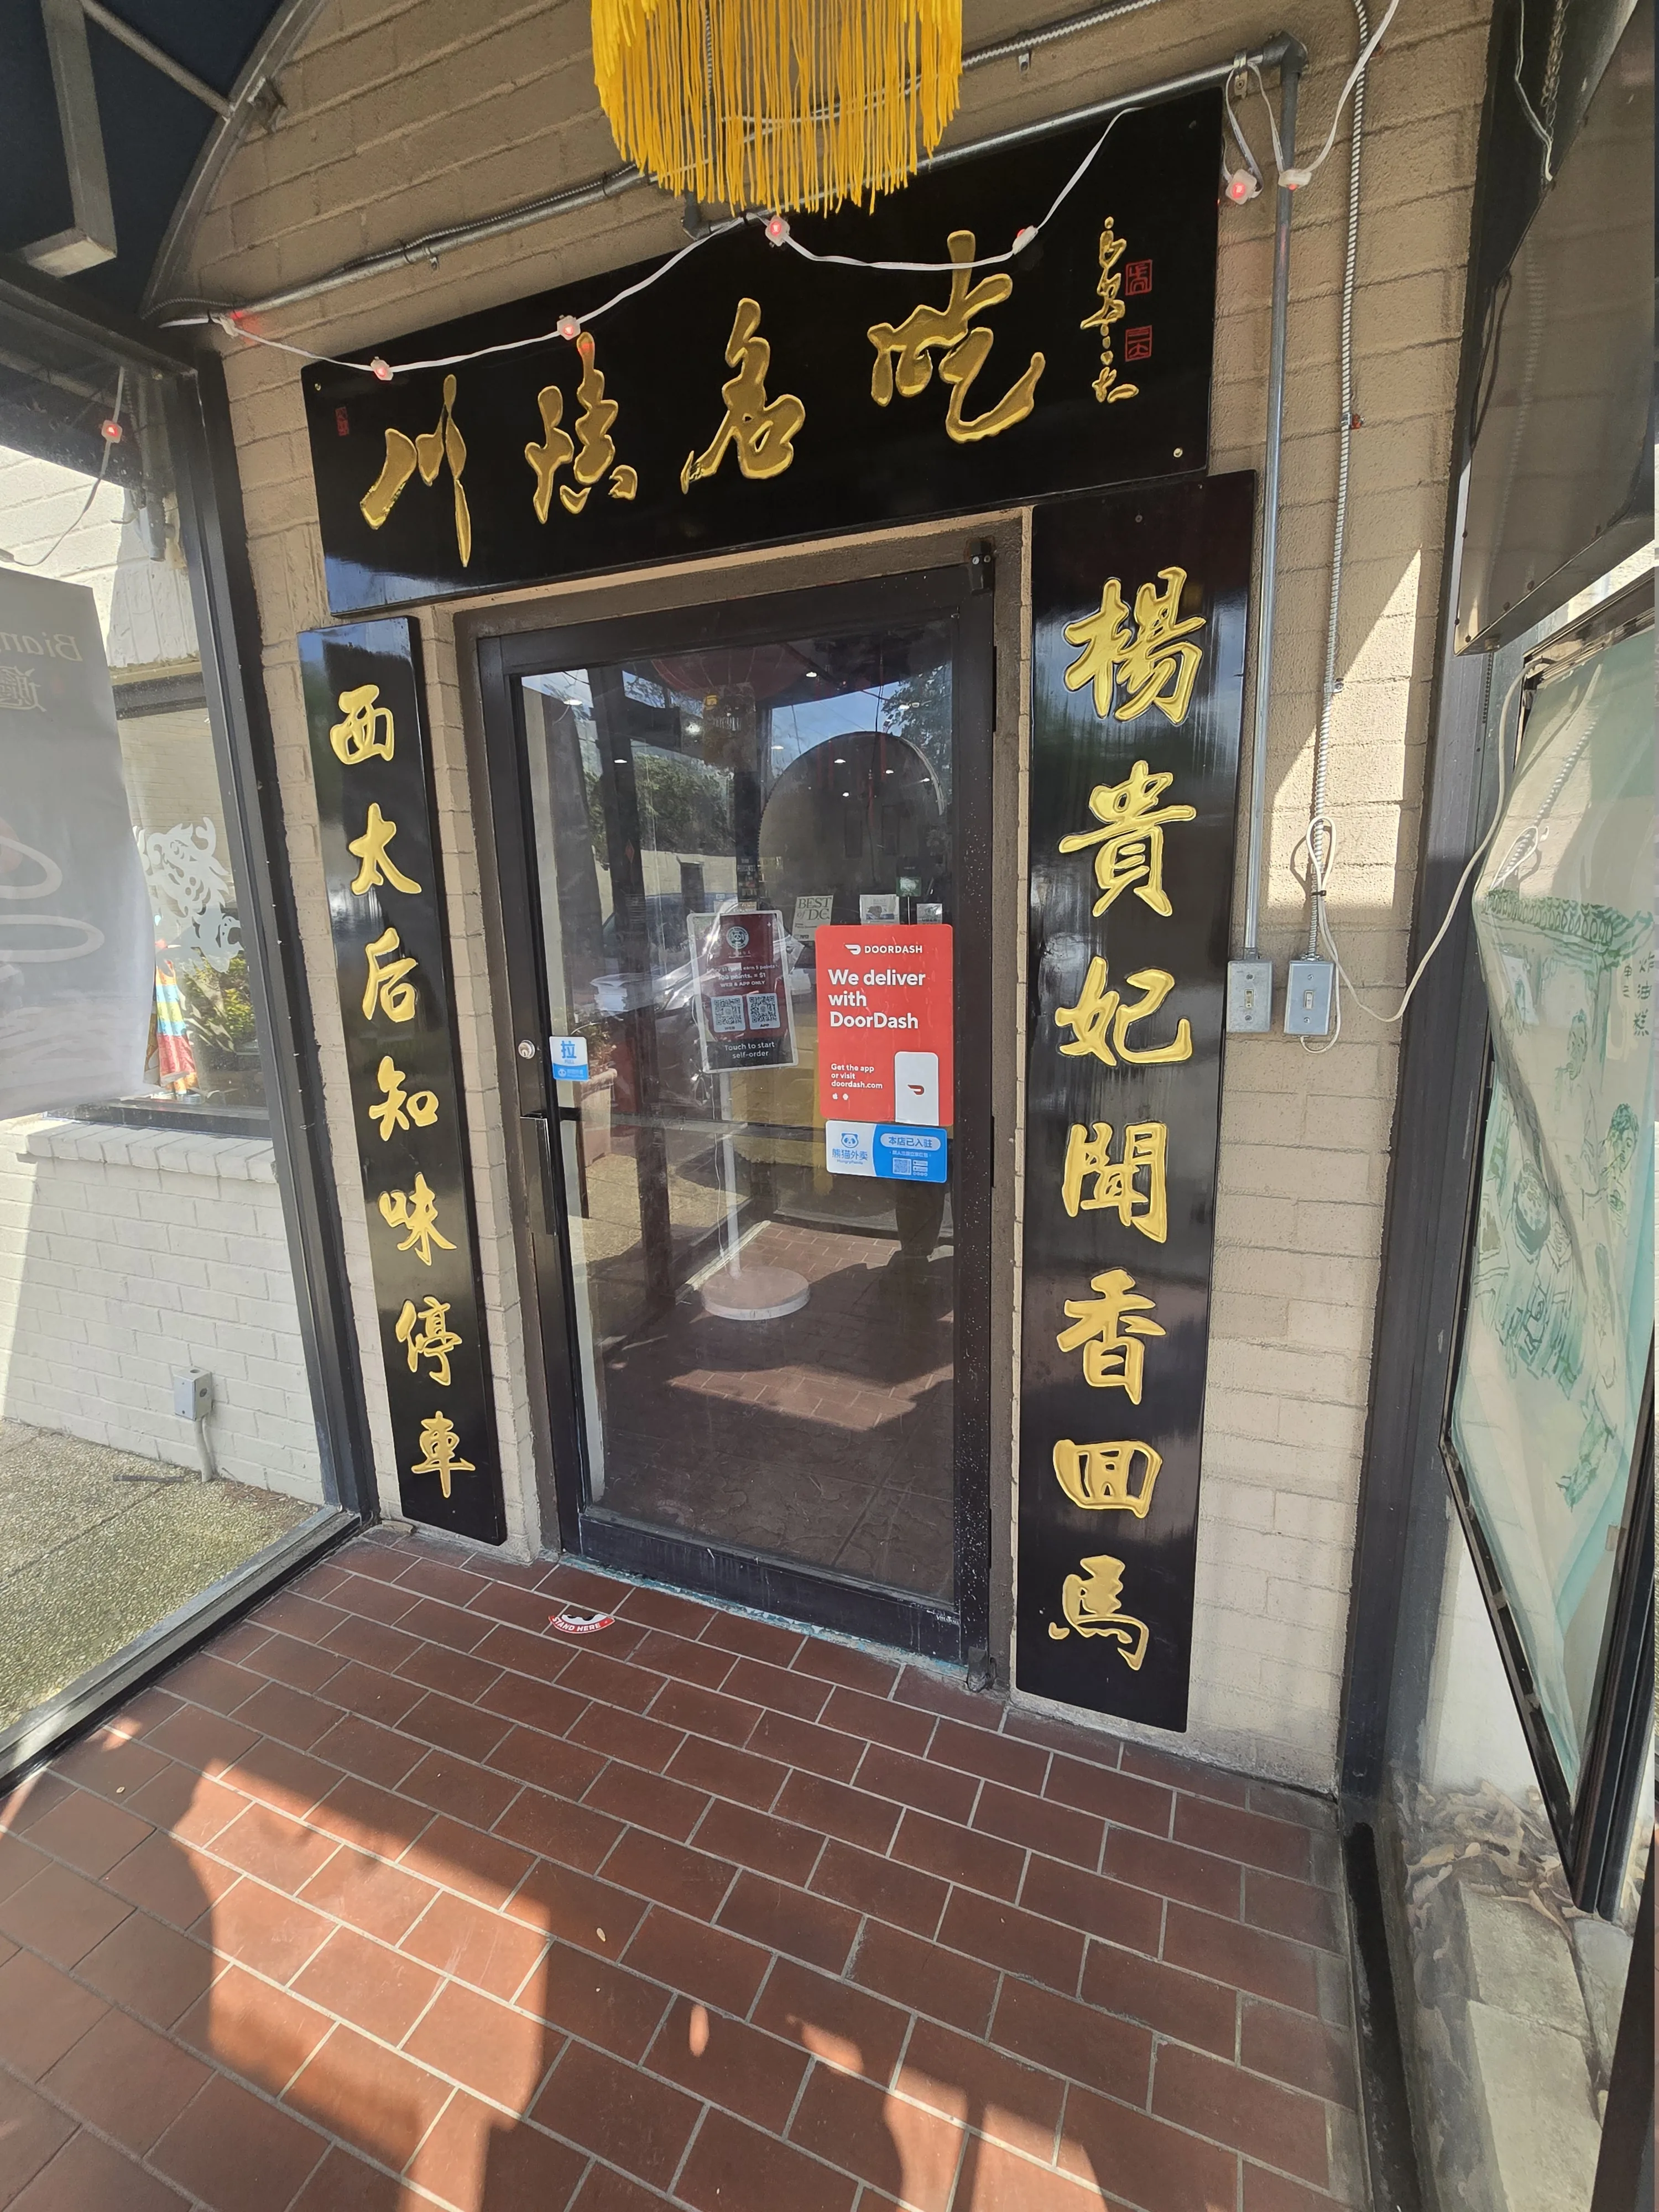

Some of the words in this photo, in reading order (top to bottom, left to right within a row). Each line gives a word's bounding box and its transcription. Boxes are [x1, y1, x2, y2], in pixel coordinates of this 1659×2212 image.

[797, 897, 832, 909] BEST
[797, 909, 806, 920] of
[864, 945, 923, 954] DOORDASH
[828, 969, 859, 985] We
[863, 969, 926, 985] deliver
[828, 990, 867, 1006] with
[830, 1011, 919, 1029] DoorDash
[560, 1040, 577, 1058] 拉
[724, 1043, 747, 1051] Touch
[732, 1050, 769, 1059] self-order
[831, 1080, 883, 1089] doordash.com
[330, 685, 476, 1498] 西太后知味停車
[889, 1136, 932, 1147] 本店已入驻
[832, 1148, 868, 1161] 熊猫外卖
[552, 1616, 575, 1631] STAND
[577, 1623, 601, 1632] HERE
